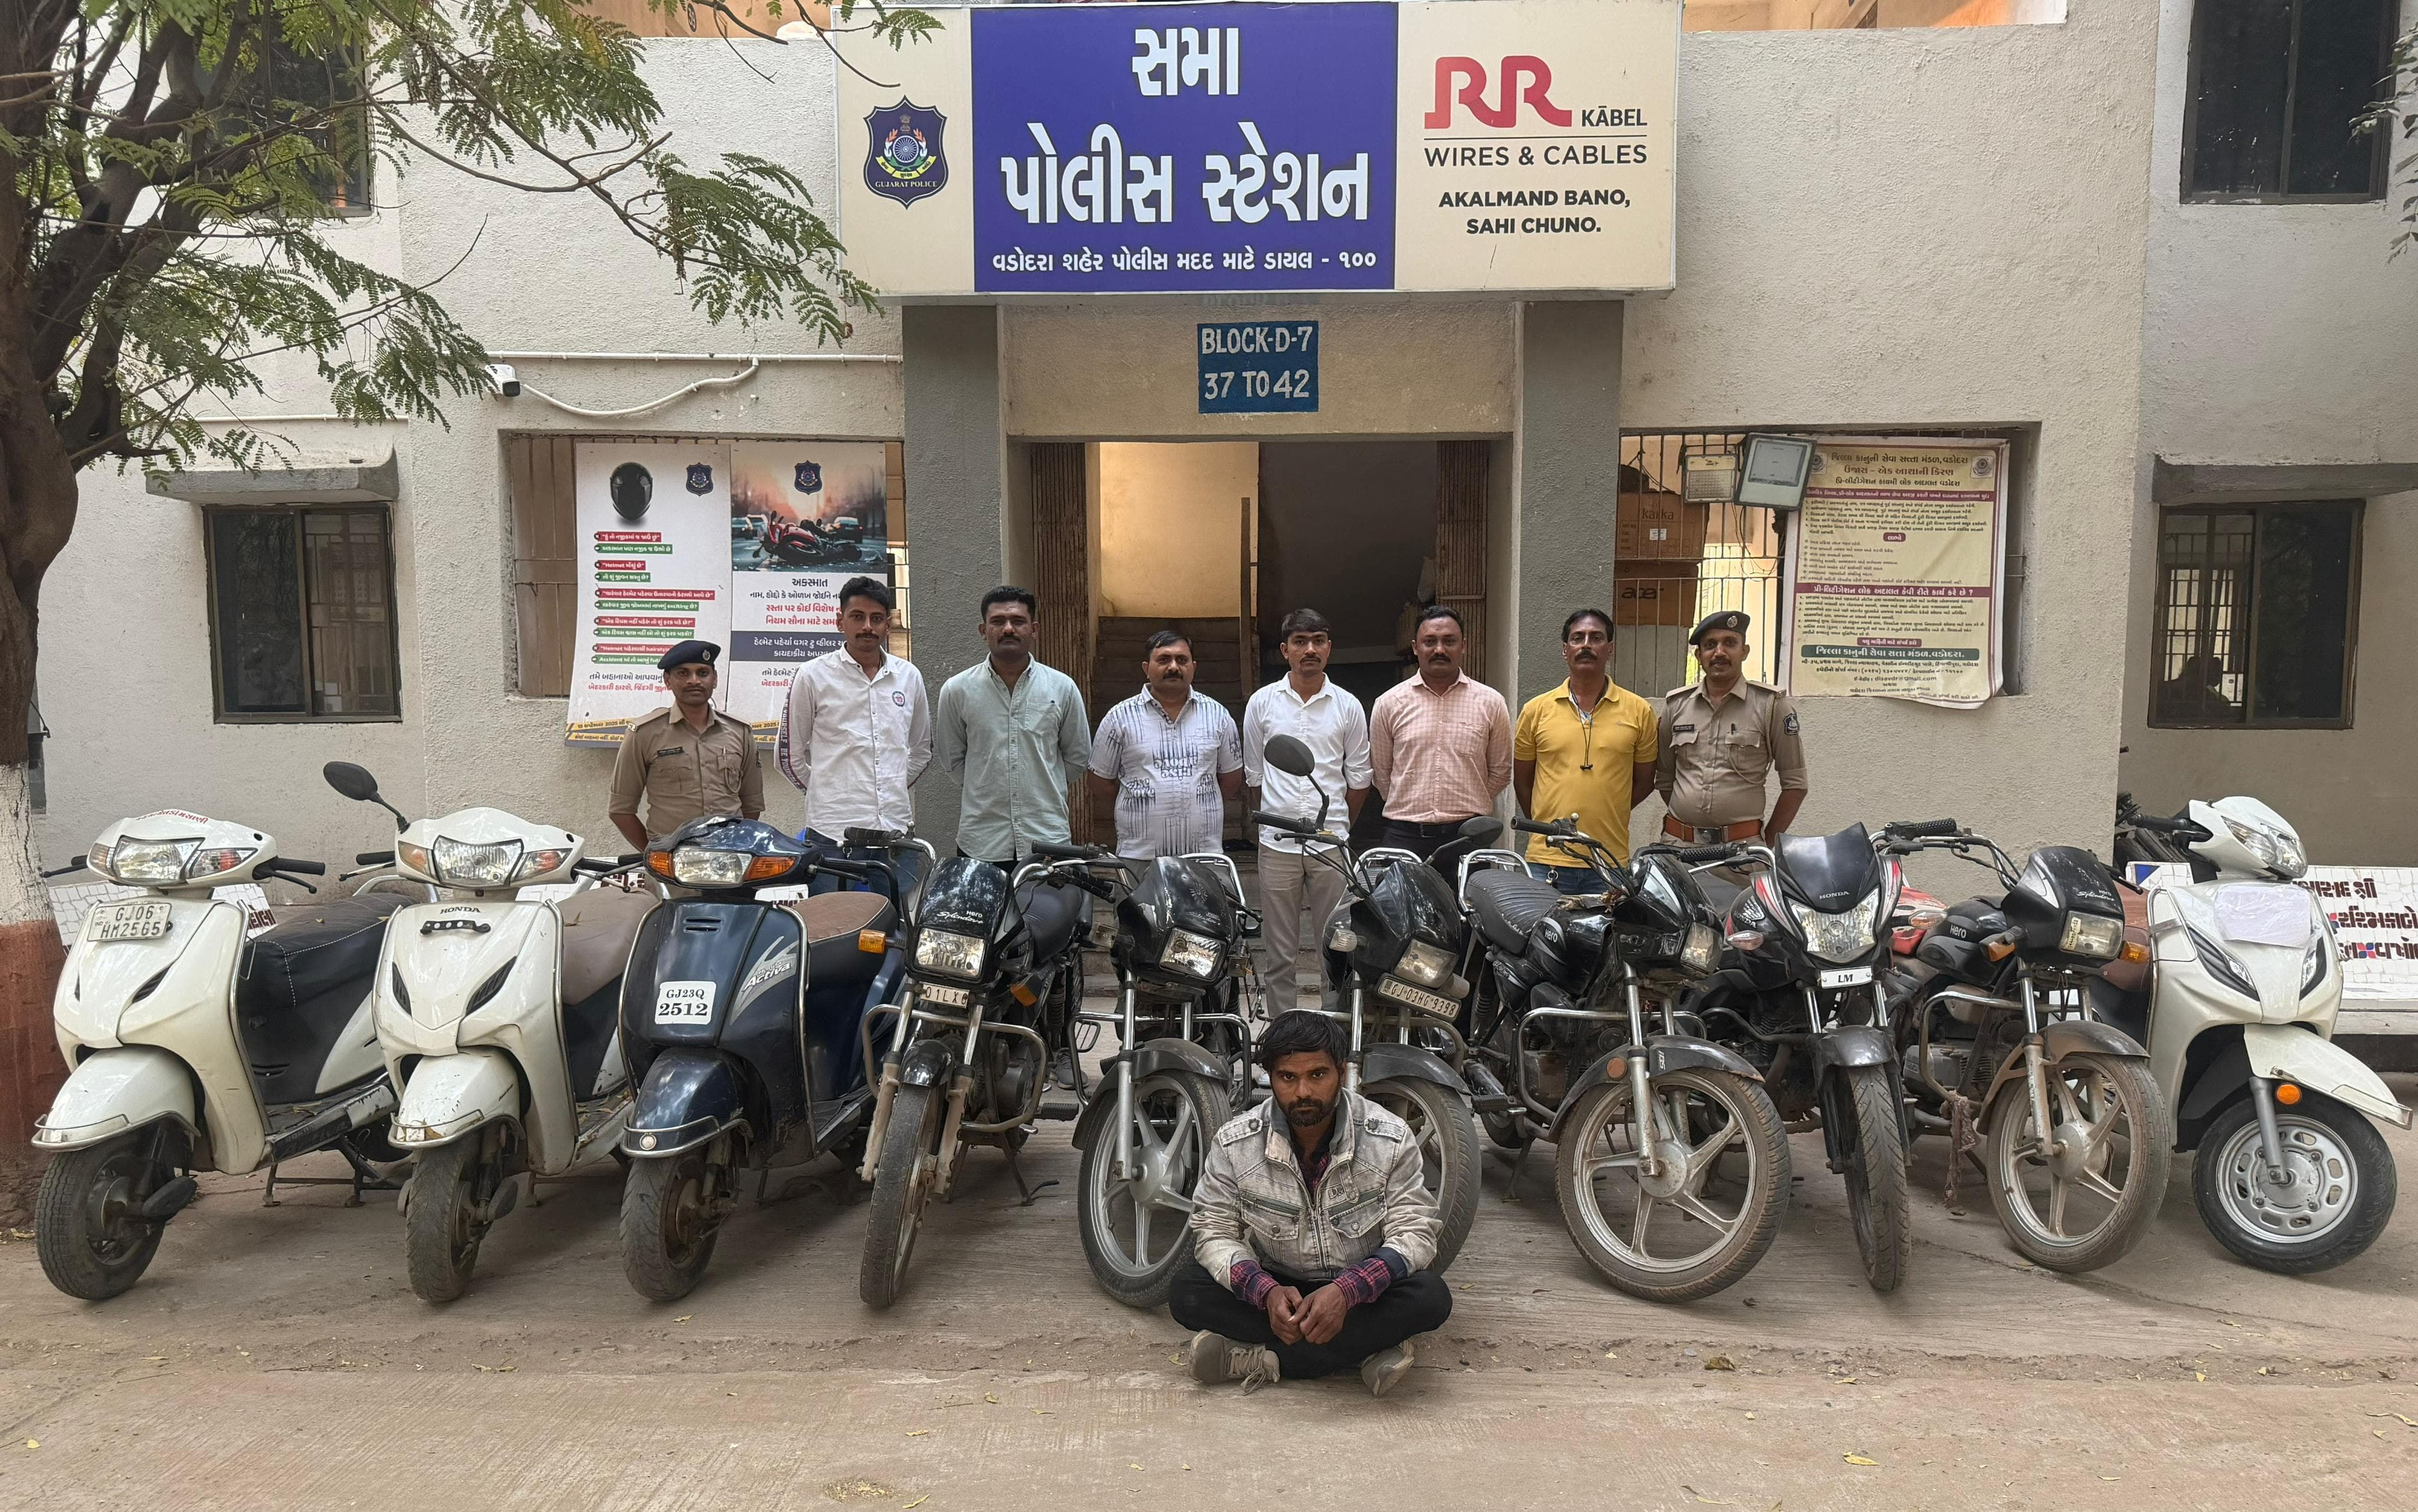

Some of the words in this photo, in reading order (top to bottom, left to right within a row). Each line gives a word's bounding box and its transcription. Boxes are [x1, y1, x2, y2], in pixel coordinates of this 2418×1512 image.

[1132, 27, 1239, 96] સમા
[1424, 55, 1572, 129] RR
[1582, 106, 1647, 127] KĀBEL
[1424, 146, 1510, 167] WIRES
[1518, 146, 1535, 166] &
[1544, 145, 1647, 165] CABLES
[1001, 122, 1172, 224] પોલીસ
[1202, 121, 1369, 224] સ્ટેશન
[1439, 190, 1558, 207] AKALMAND
[1565, 189, 1631, 208] BANO,
[1466, 218, 1515, 234] SAHI
[1522, 217, 1601, 233] CHUNO.
[992, 246, 1054, 272] વડોદરા
[1063, 246, 1103, 273] શહેર
[1112, 246, 1168, 271] પોલીસ
[1176, 251, 1214, 271] મદદ
[1222, 245, 1255, 270] માટે
[1264, 250, 1312, 270] ડાયલ
[1339, 250, 1376, 268] ૧૦૦
[1202, 326, 1313, 354] BLOCK-D-7
[1204, 371, 1235, 400] 37
[1242, 370, 1270, 397] TO
[1273, 369, 1310, 399] 42
[1882, 454, 1897, 463] સેવા
[792, 578, 828, 587] અકસ્માત
[781, 590, 786, 599] કે
[788, 591, 811, 599] ઓળખ
[796, 603, 811, 612] કોઈ
[813, 603, 834, 612] વિશેષ
[766, 614, 786, 625] નિયમ
[788, 615, 805, 625] સૌના
[807, 615, 820, 625] માટે
[754, 637, 773, 646] હેલ્મેટ
[774, 648, 806, 657] કાયદાકીય
[1816, 645, 1841, 655] જિલ્લા
[1843, 646, 1868, 657] કાનુની
[1869, 647, 1886, 656] સેવા
[589, 671, 600, 680] તમે
[602, 672, 634, 680] બહાનાઓ
[762, 668, 773, 676] તમે
[781, 748, 788, 757] BE
[1819, 890, 1850, 900] HONDA
[115, 905, 155, 921] GJ06
[967, 910, 983, 918] Hero
[1733, 911, 1758, 929] HONDA
[1544, 929, 1558, 943] Hero
[1950, 924, 1967, 939] Hero
[742, 962, 792, 993] Activa
[1838, 973, 1853, 983] LM
[666, 988, 705, 999] GJ23Q
[658, 1003, 708, 1016] 2512
